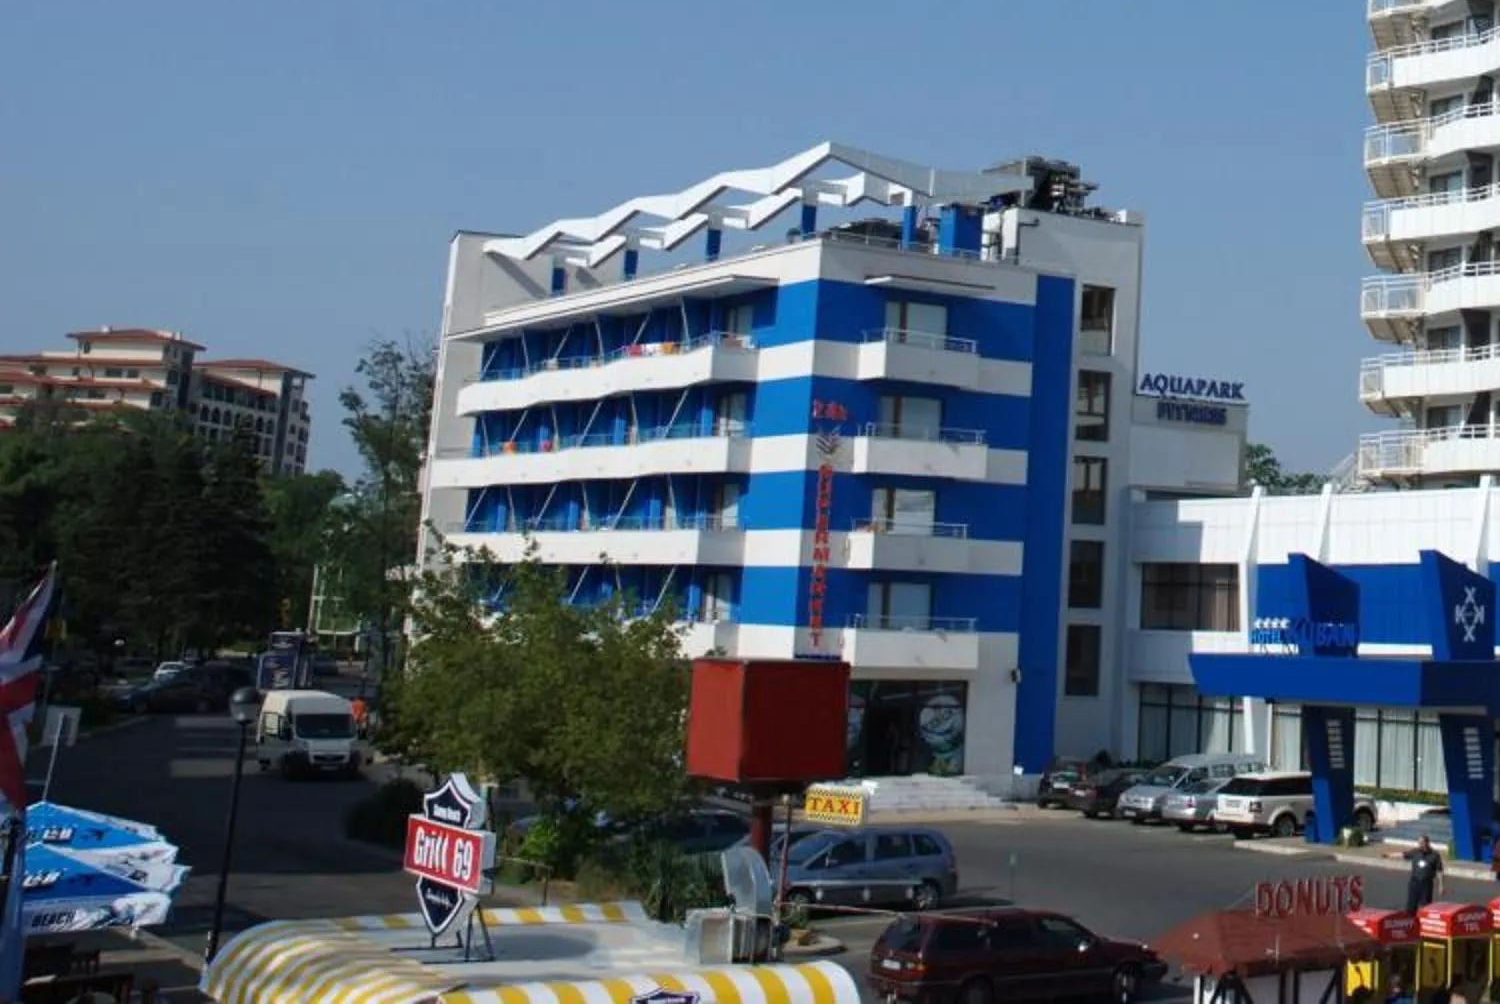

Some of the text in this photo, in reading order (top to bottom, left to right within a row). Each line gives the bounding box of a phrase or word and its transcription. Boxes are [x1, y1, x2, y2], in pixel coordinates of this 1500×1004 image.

[1140, 373, 1246, 400] AQUAPARK
[811, 797, 861, 815] TAXI
[453, 837, 474, 881] 69
[1256, 876, 1364, 918] DONUTS
